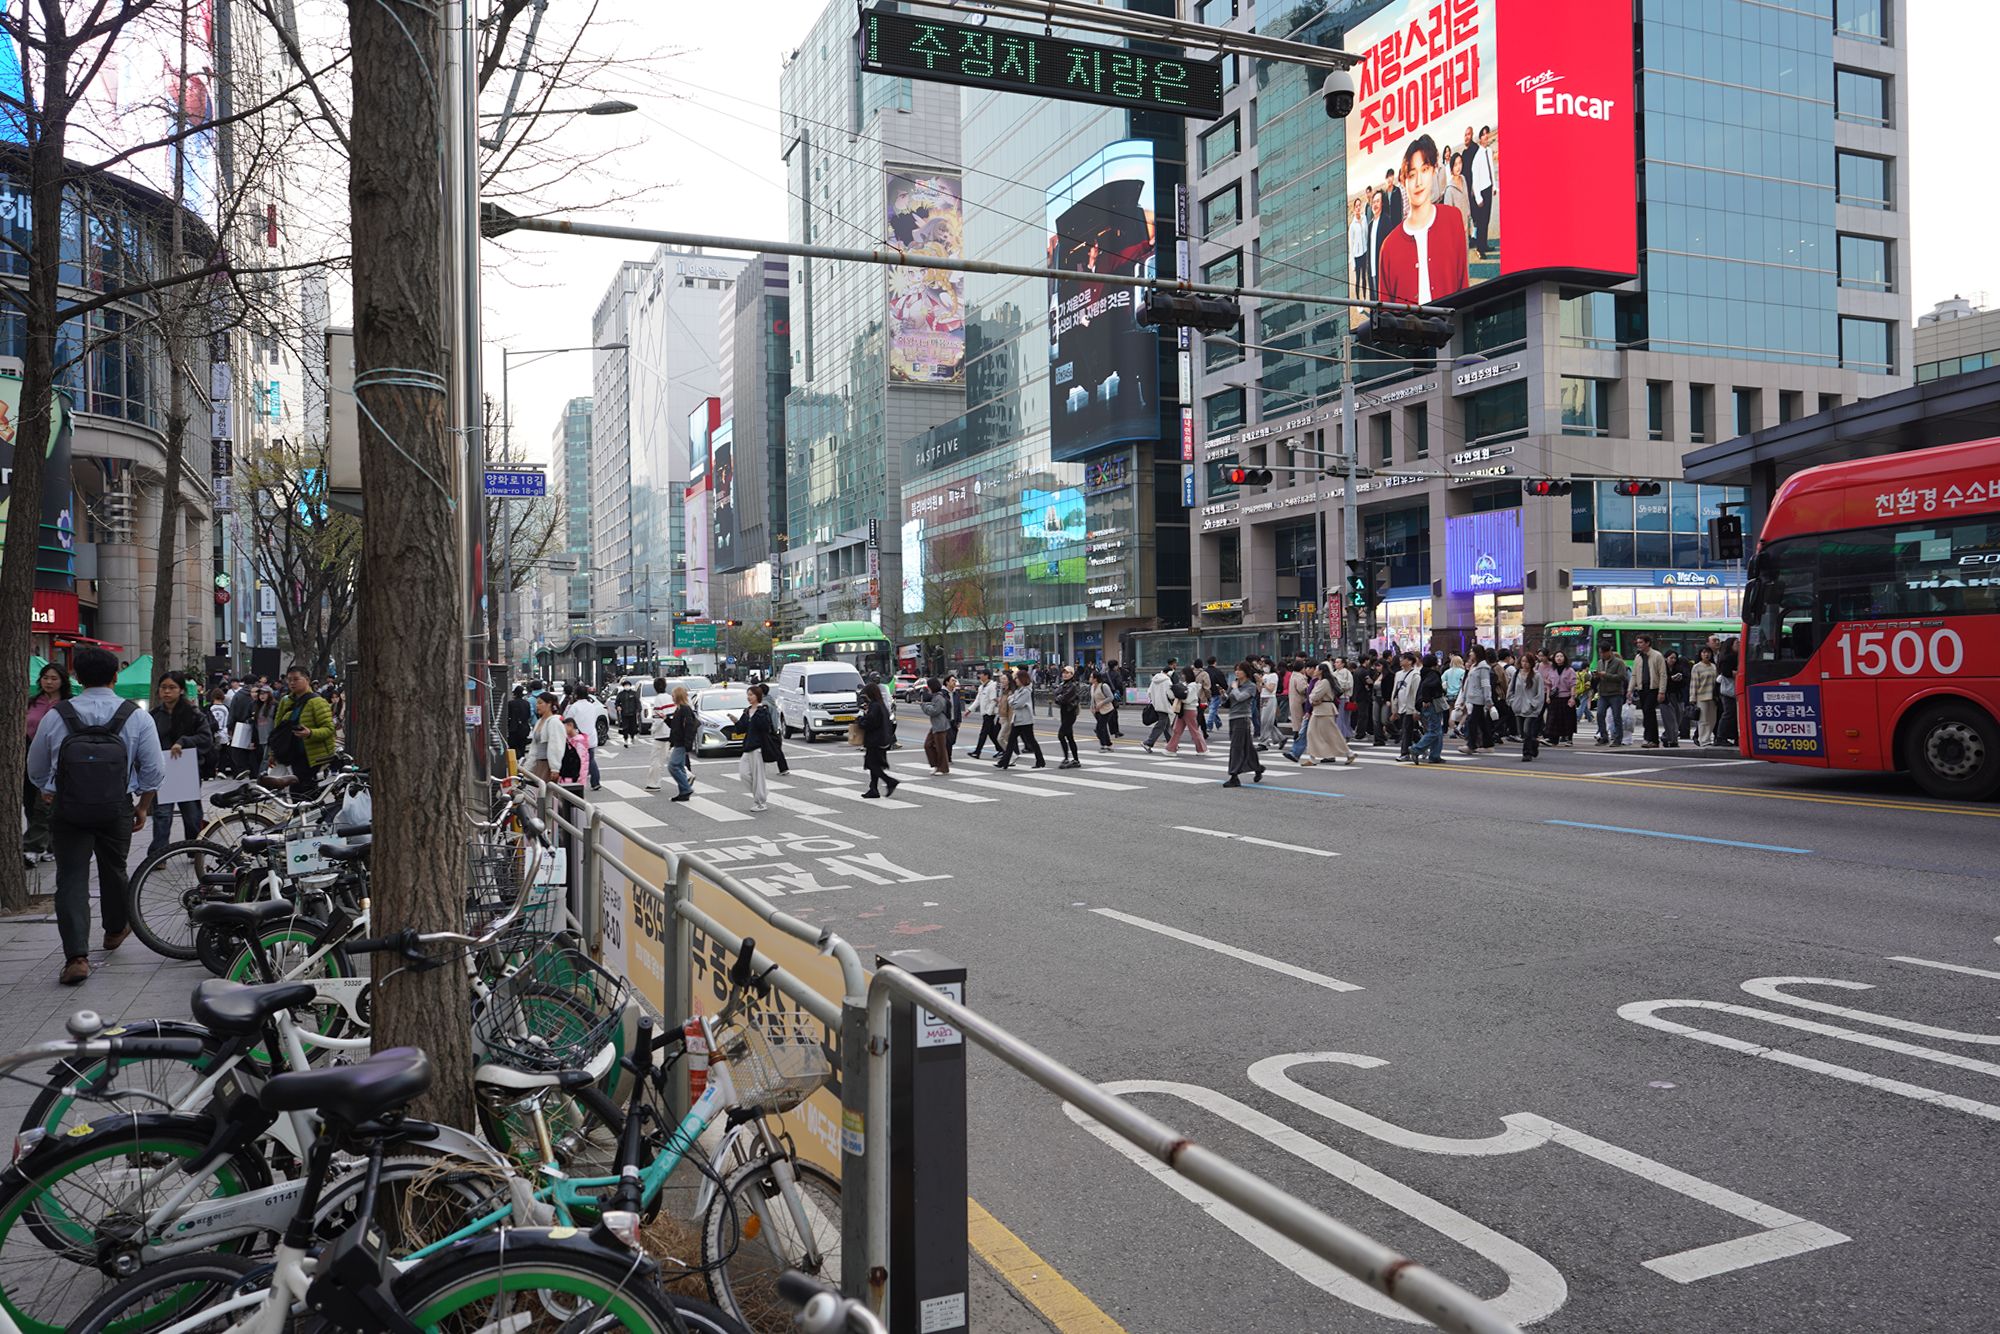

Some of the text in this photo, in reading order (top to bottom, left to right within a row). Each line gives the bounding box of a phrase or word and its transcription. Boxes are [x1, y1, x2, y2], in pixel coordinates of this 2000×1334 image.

[1358, 0, 1479, 103] 자랑스러운
[909, 24, 1040, 84] 주정차
[1066, 46, 1189, 105] 차량은
[1516, 69, 1565, 94] Trust
[1360, 43, 1480, 155] 주인이돼라
[1535, 87, 1614, 121] Encar
[1108, 290, 1131, 310] 것은
[915, 438, 959, 467] FASTFIVE
[1455, 448, 1490, 464] 나인의원
[486, 474, 543, 487] 양화로18길
[1085, 457, 1125, 487] EXIT
[1454, 465, 1506, 483] RBUCKS
[521, 487, 543, 496] 18-gil
[1875, 488, 1937, 518] 친환경
[32, 607, 48, 623] ha
[1841, 621, 1921, 632] UNIVERSE
[838, 642, 875, 653] 7711
[1837, 629, 1964, 676] 1500
[1755, 704, 1816, 718] 중흥S-클래스
[1776, 723, 1806, 734] OPEN
[1767, 738, 1818, 751] 562-1990
[722, 852, 955, 897] 자전
[343, 979, 362, 987] 53320
[264, 1190, 299, 1207] 61141
